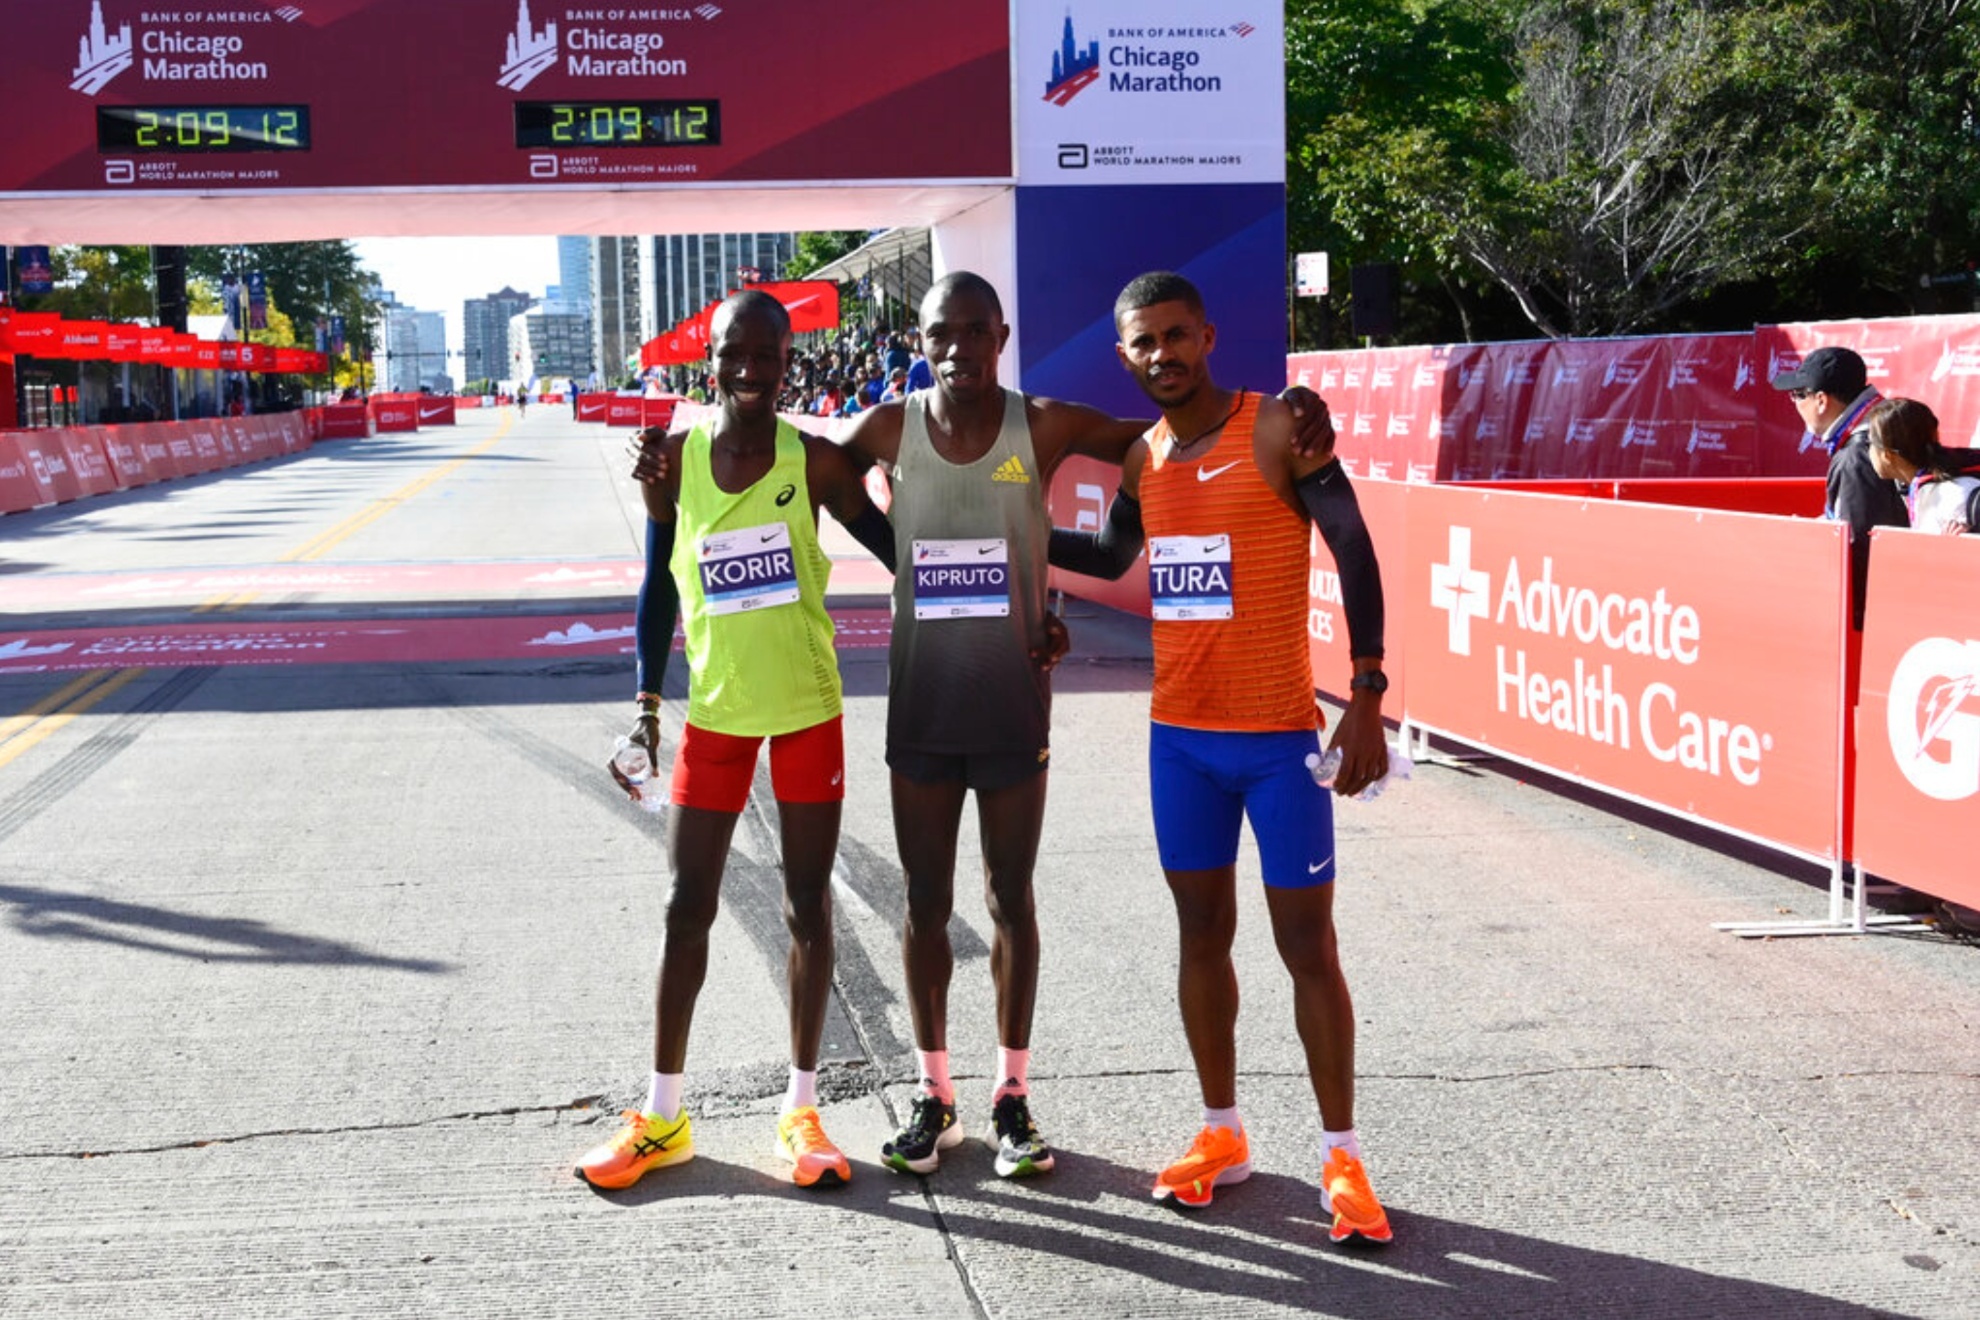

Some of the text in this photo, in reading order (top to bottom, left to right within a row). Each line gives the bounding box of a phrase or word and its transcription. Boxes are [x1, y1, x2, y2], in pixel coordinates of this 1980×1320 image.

[141, 11, 271, 23] BANK OF AMERICA
[567, 9, 692, 21] BANK OF AMERICA
[567, 28, 664, 55] Chicago
[1108, 28, 1227, 38] BANK OF AMERICA
[142, 30, 243, 58] Chicago
[568, 54, 687, 76] Marathon
[1109, 46, 1200, 71] Chicago
[143, 58, 267, 81] Marathon
[1110, 72, 1221, 92] Marathon
[563, 156, 599, 165] ABBOTT
[1094, 146, 1134, 155] ABBOTT
[1094, 155, 1242, 166] WORLD MARATHON MAJORS
[139, 162, 177, 171] ABBOTT
[139, 169, 280, 180] WORLD MARATHON MAJORS
[563, 164, 698, 175] WORLD MARATHON MAJORS
[703, 552, 791, 588] KORIR
[917, 567, 1005, 587] KIPRUTO
[1151, 564, 1229, 594] TURA
[1309, 567, 1344, 607] ULTA
[1496, 556, 1700, 664] Advocate
[1308, 608, 1334, 644] CES
[1496, 645, 1761, 786] Health Care
